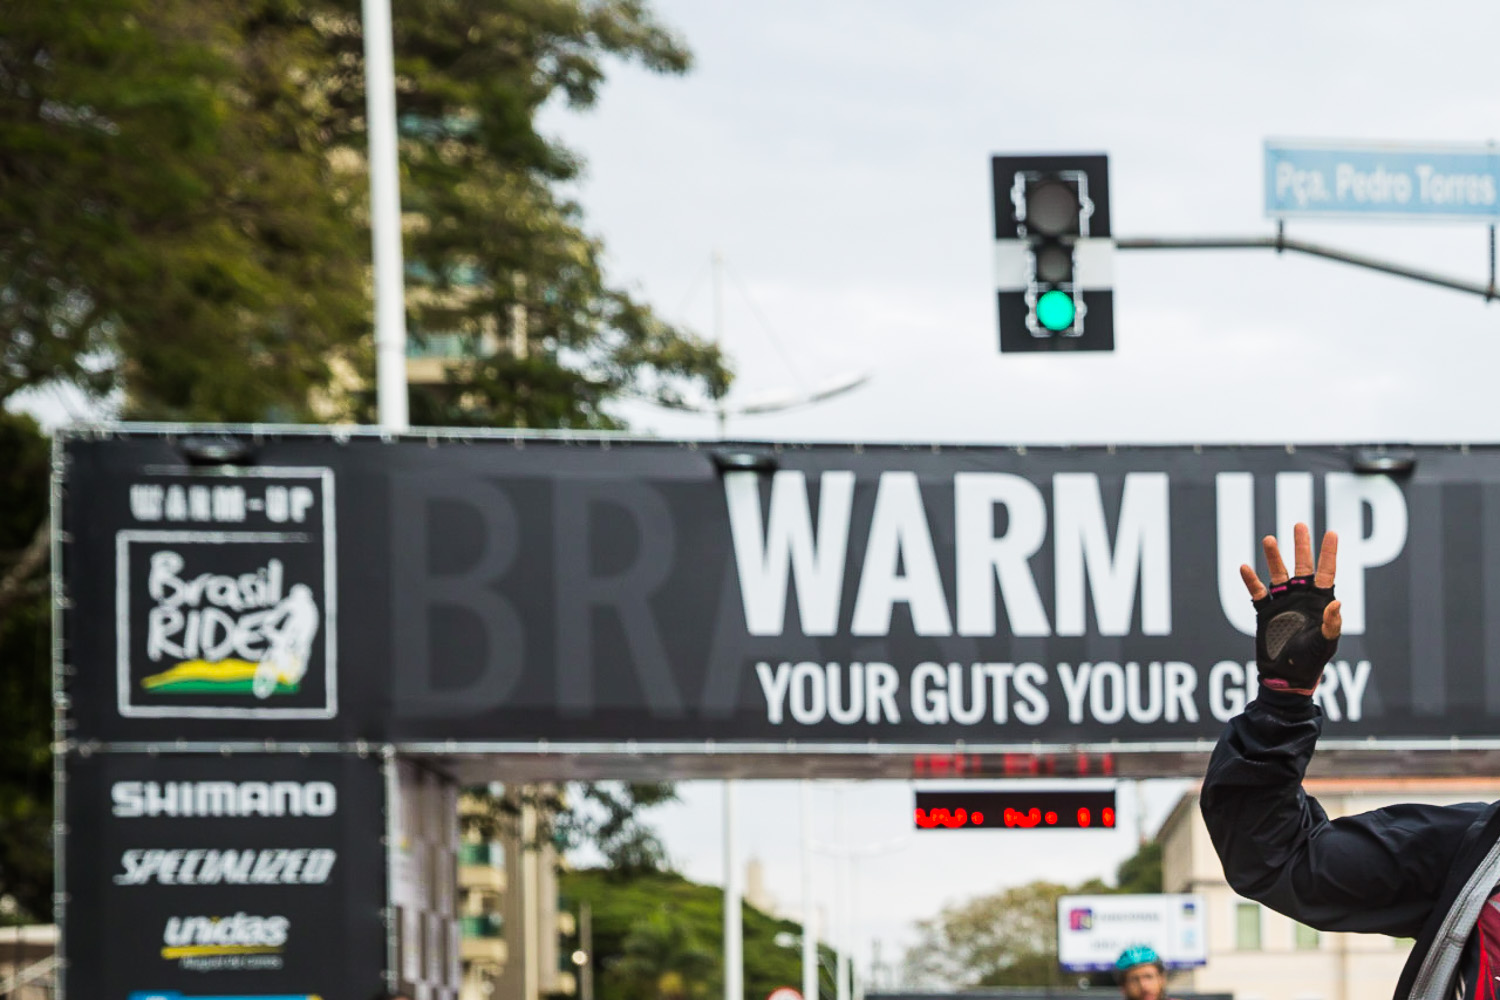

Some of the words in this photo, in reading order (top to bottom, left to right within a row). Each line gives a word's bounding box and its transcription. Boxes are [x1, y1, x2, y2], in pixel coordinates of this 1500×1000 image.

[1335, 161, 1412, 204] Pedro
[1415, 163, 1497, 206] Torres
[129, 483, 314, 522] WARM-UP
[724, 470, 1172, 637] WARM
[1215, 471, 1408, 638] UP
[148, 550, 284, 612] Brasil
[756, 661, 900, 725] YOUR
[911, 661, 1050, 725] GUTS
[1057, 661, 1199, 724] YOUR
[111, 781, 336, 818] SHIMANO
[113, 848, 337, 885] SPECIALIZED
[163, 911, 290, 947] unidas
